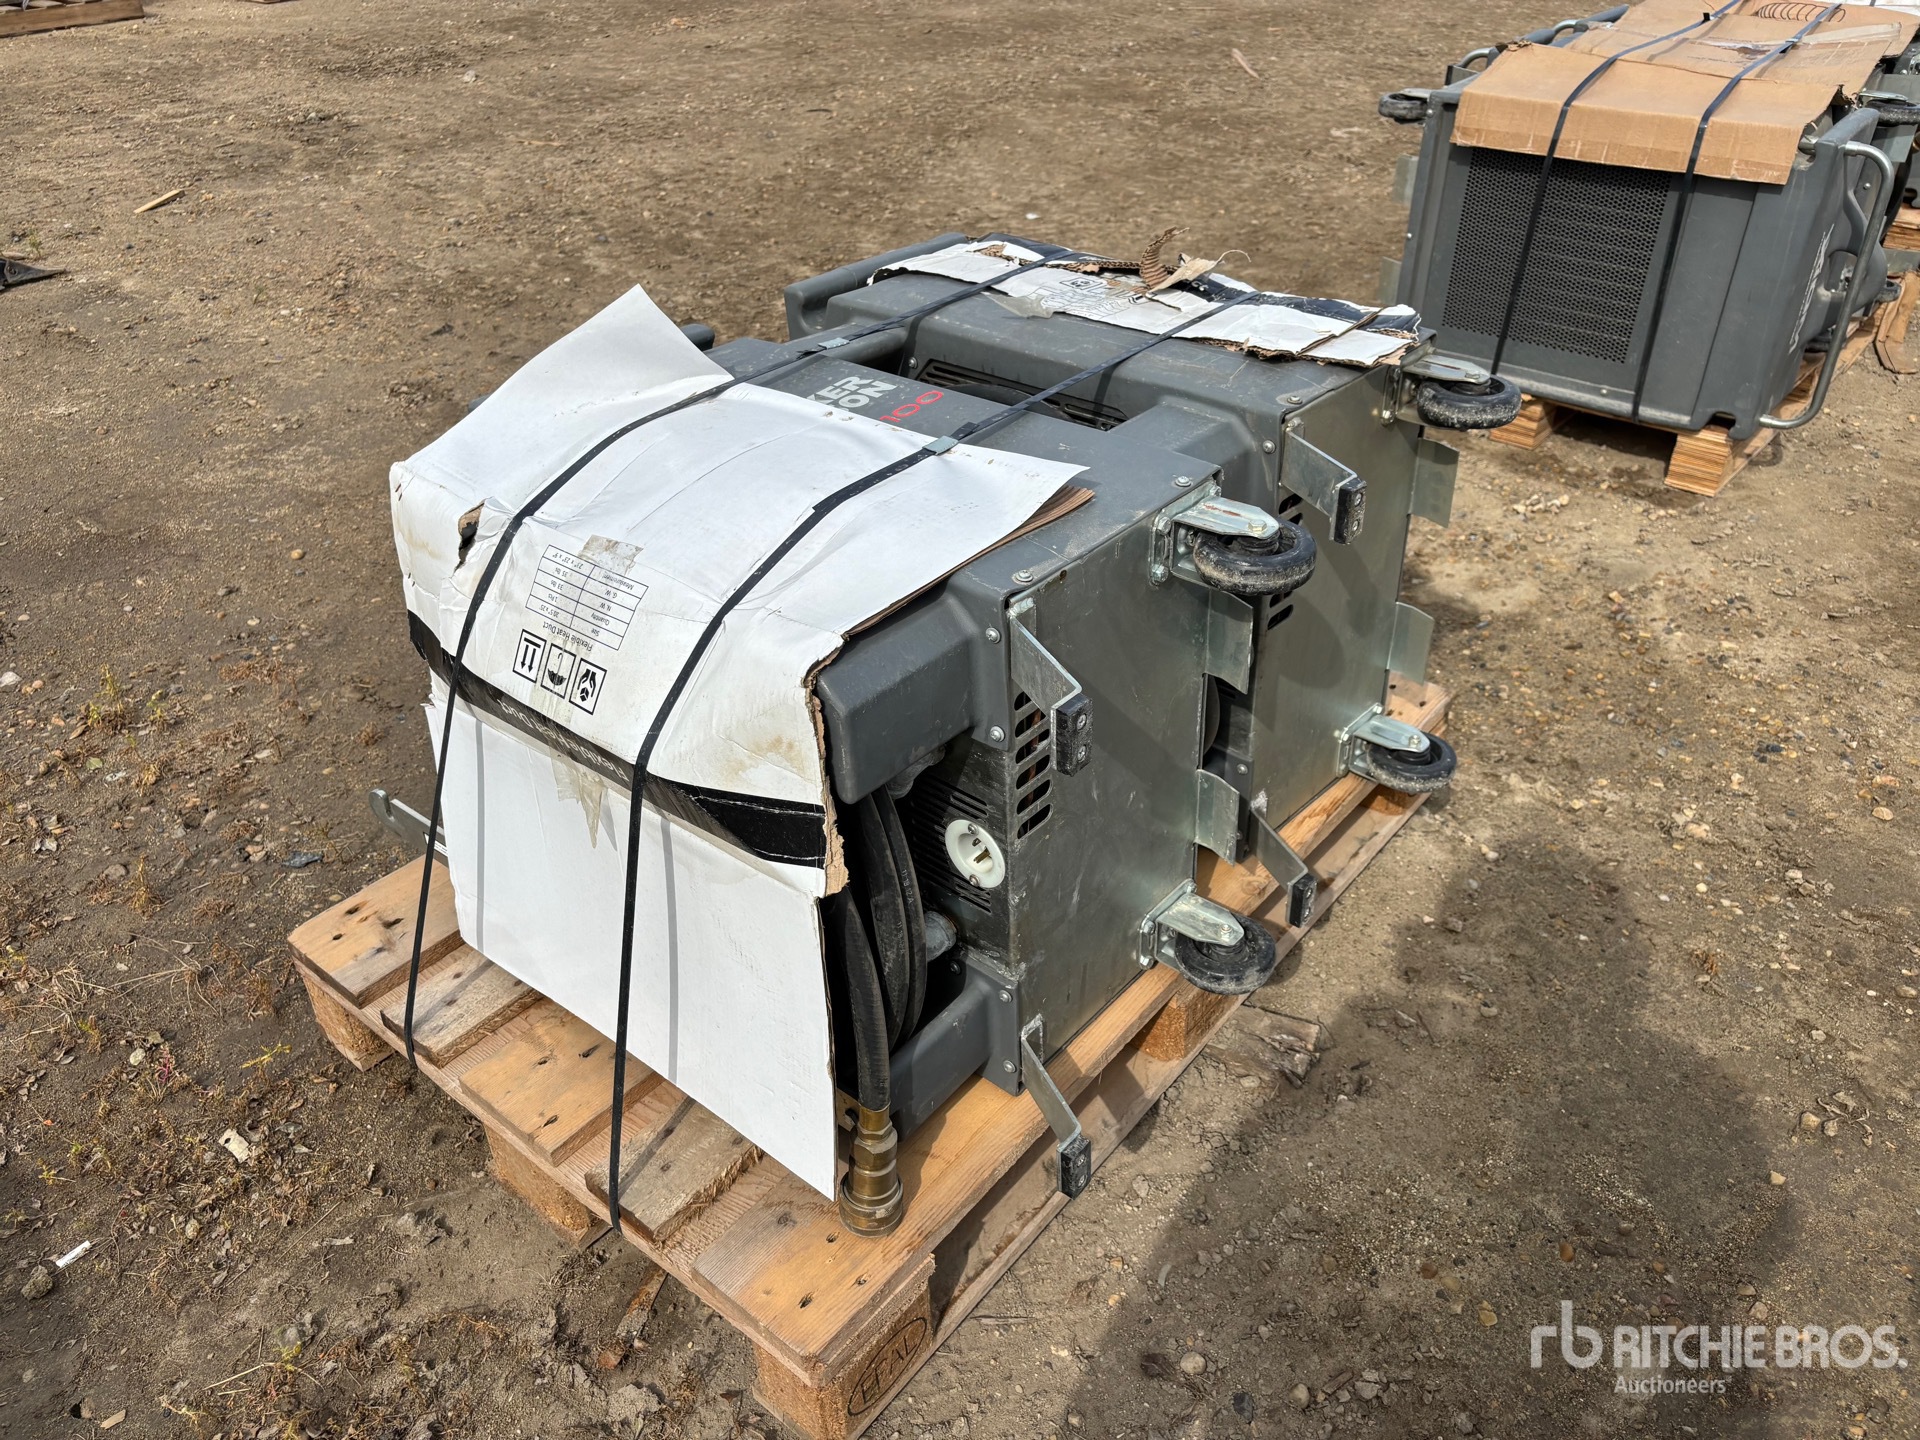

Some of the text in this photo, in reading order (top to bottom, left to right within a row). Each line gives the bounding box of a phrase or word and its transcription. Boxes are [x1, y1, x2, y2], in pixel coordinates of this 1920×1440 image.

[591, 612, 610, 626] Quantity
[543, 621, 593, 652] Flexible Heat Duct
[591, 628, 600, 637] Size
[497, 699, 630, 782] Flexible Heat Duct
